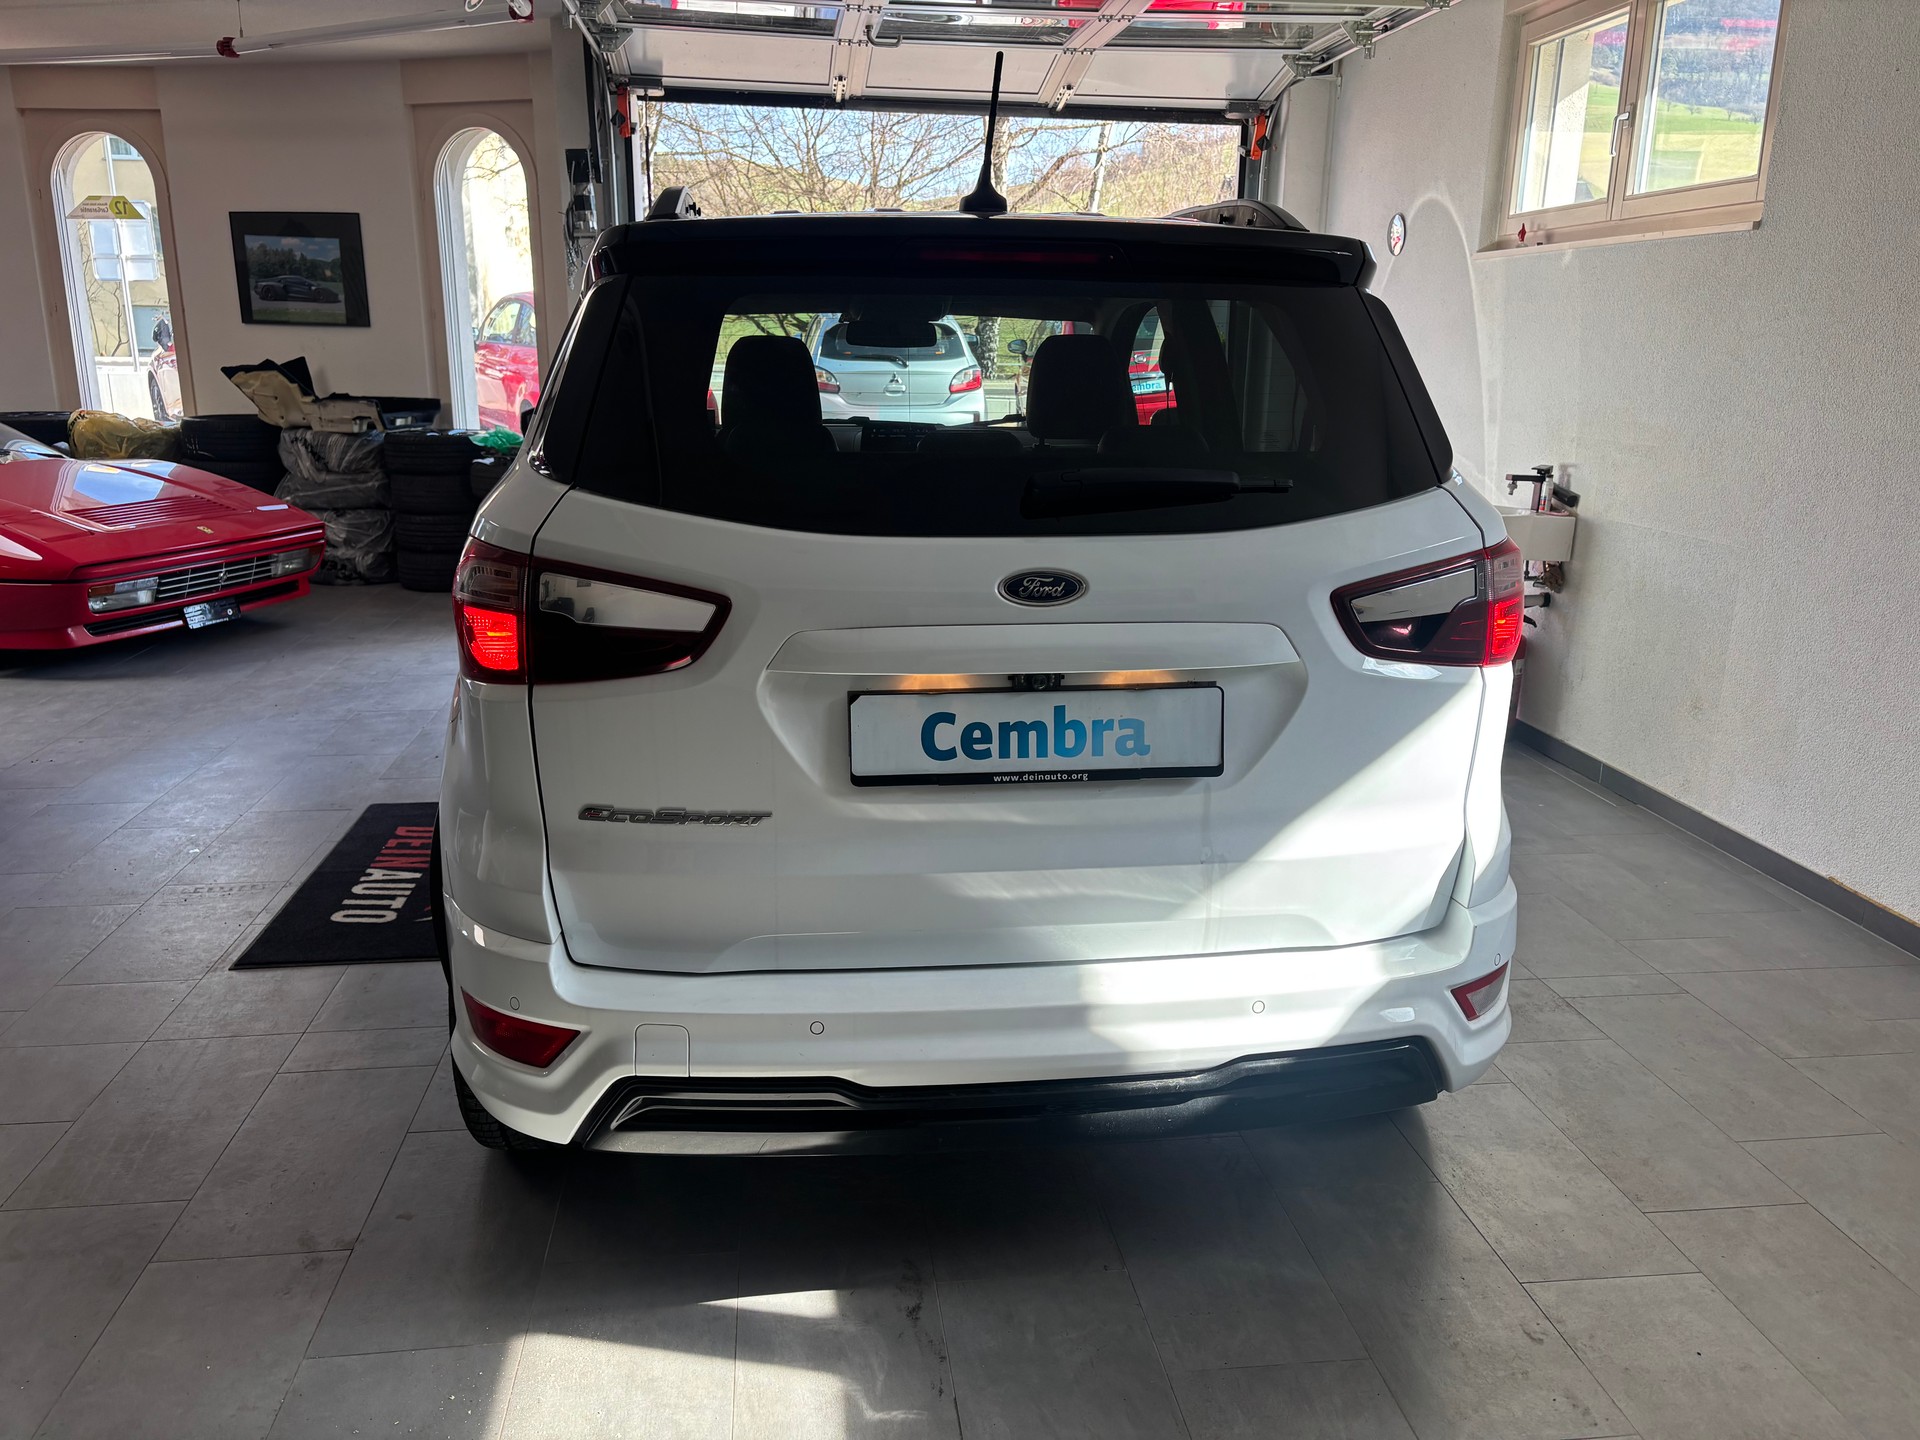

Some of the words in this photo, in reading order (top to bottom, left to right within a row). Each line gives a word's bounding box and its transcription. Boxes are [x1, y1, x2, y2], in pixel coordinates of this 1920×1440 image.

[1132, 382, 1161, 391] embra
[1019, 576, 1065, 597] Ford
[921, 704, 1151, 761] Cembra
[993, 773, 1089, 782] www.deinauto.org
